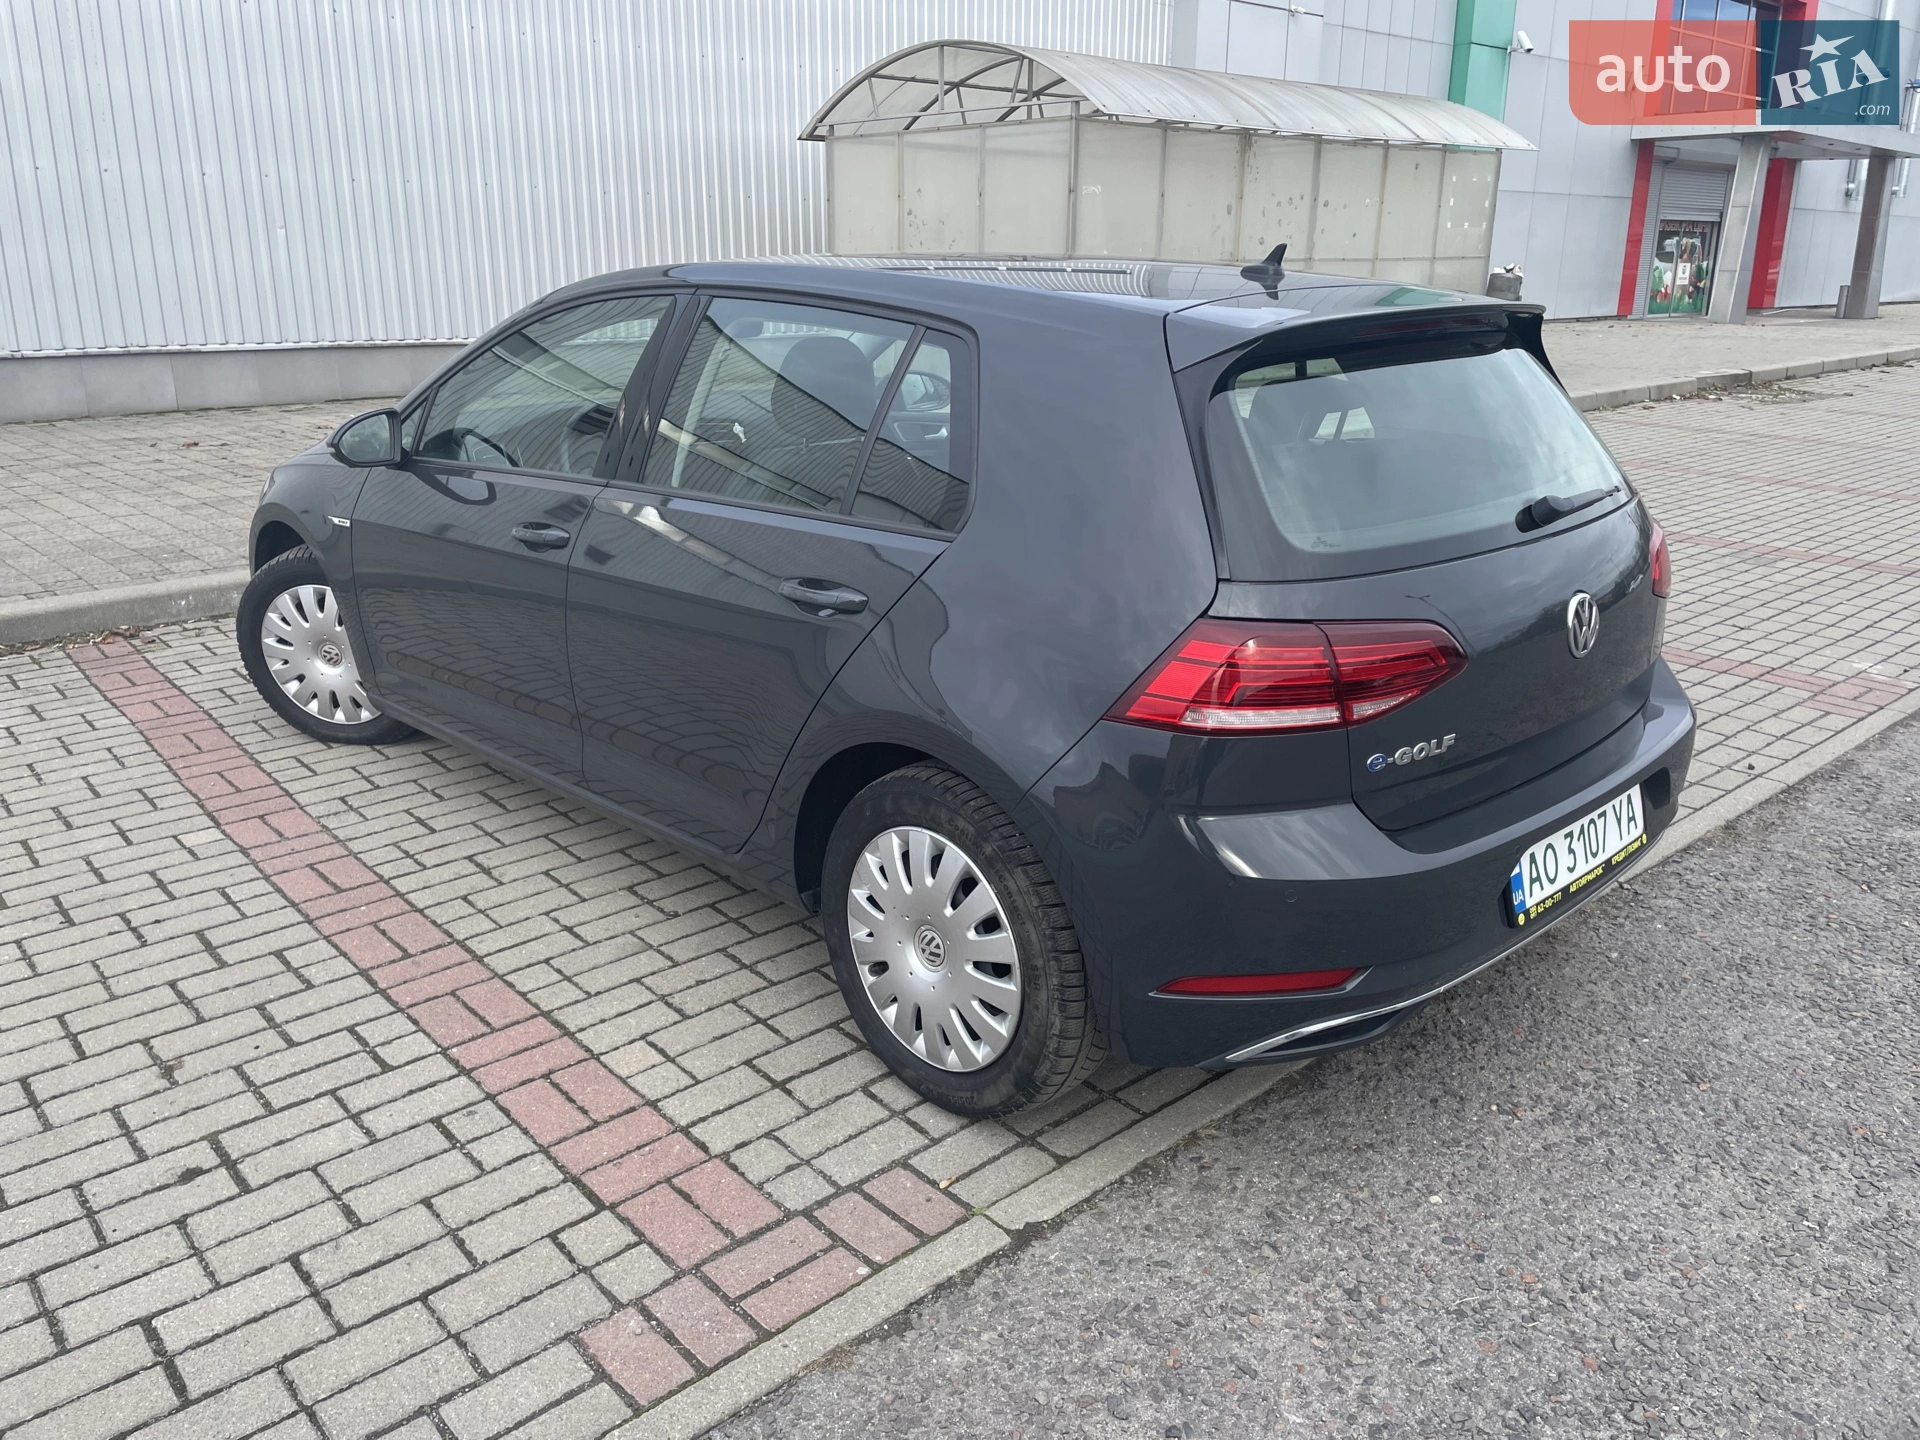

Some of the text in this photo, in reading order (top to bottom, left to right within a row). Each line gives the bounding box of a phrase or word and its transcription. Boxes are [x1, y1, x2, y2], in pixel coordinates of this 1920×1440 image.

[1366, 733, 1456, 773] e-GOLF
[1528, 792, 1638, 899] AO 3107 YA
[1513, 891, 1524, 905] UA
